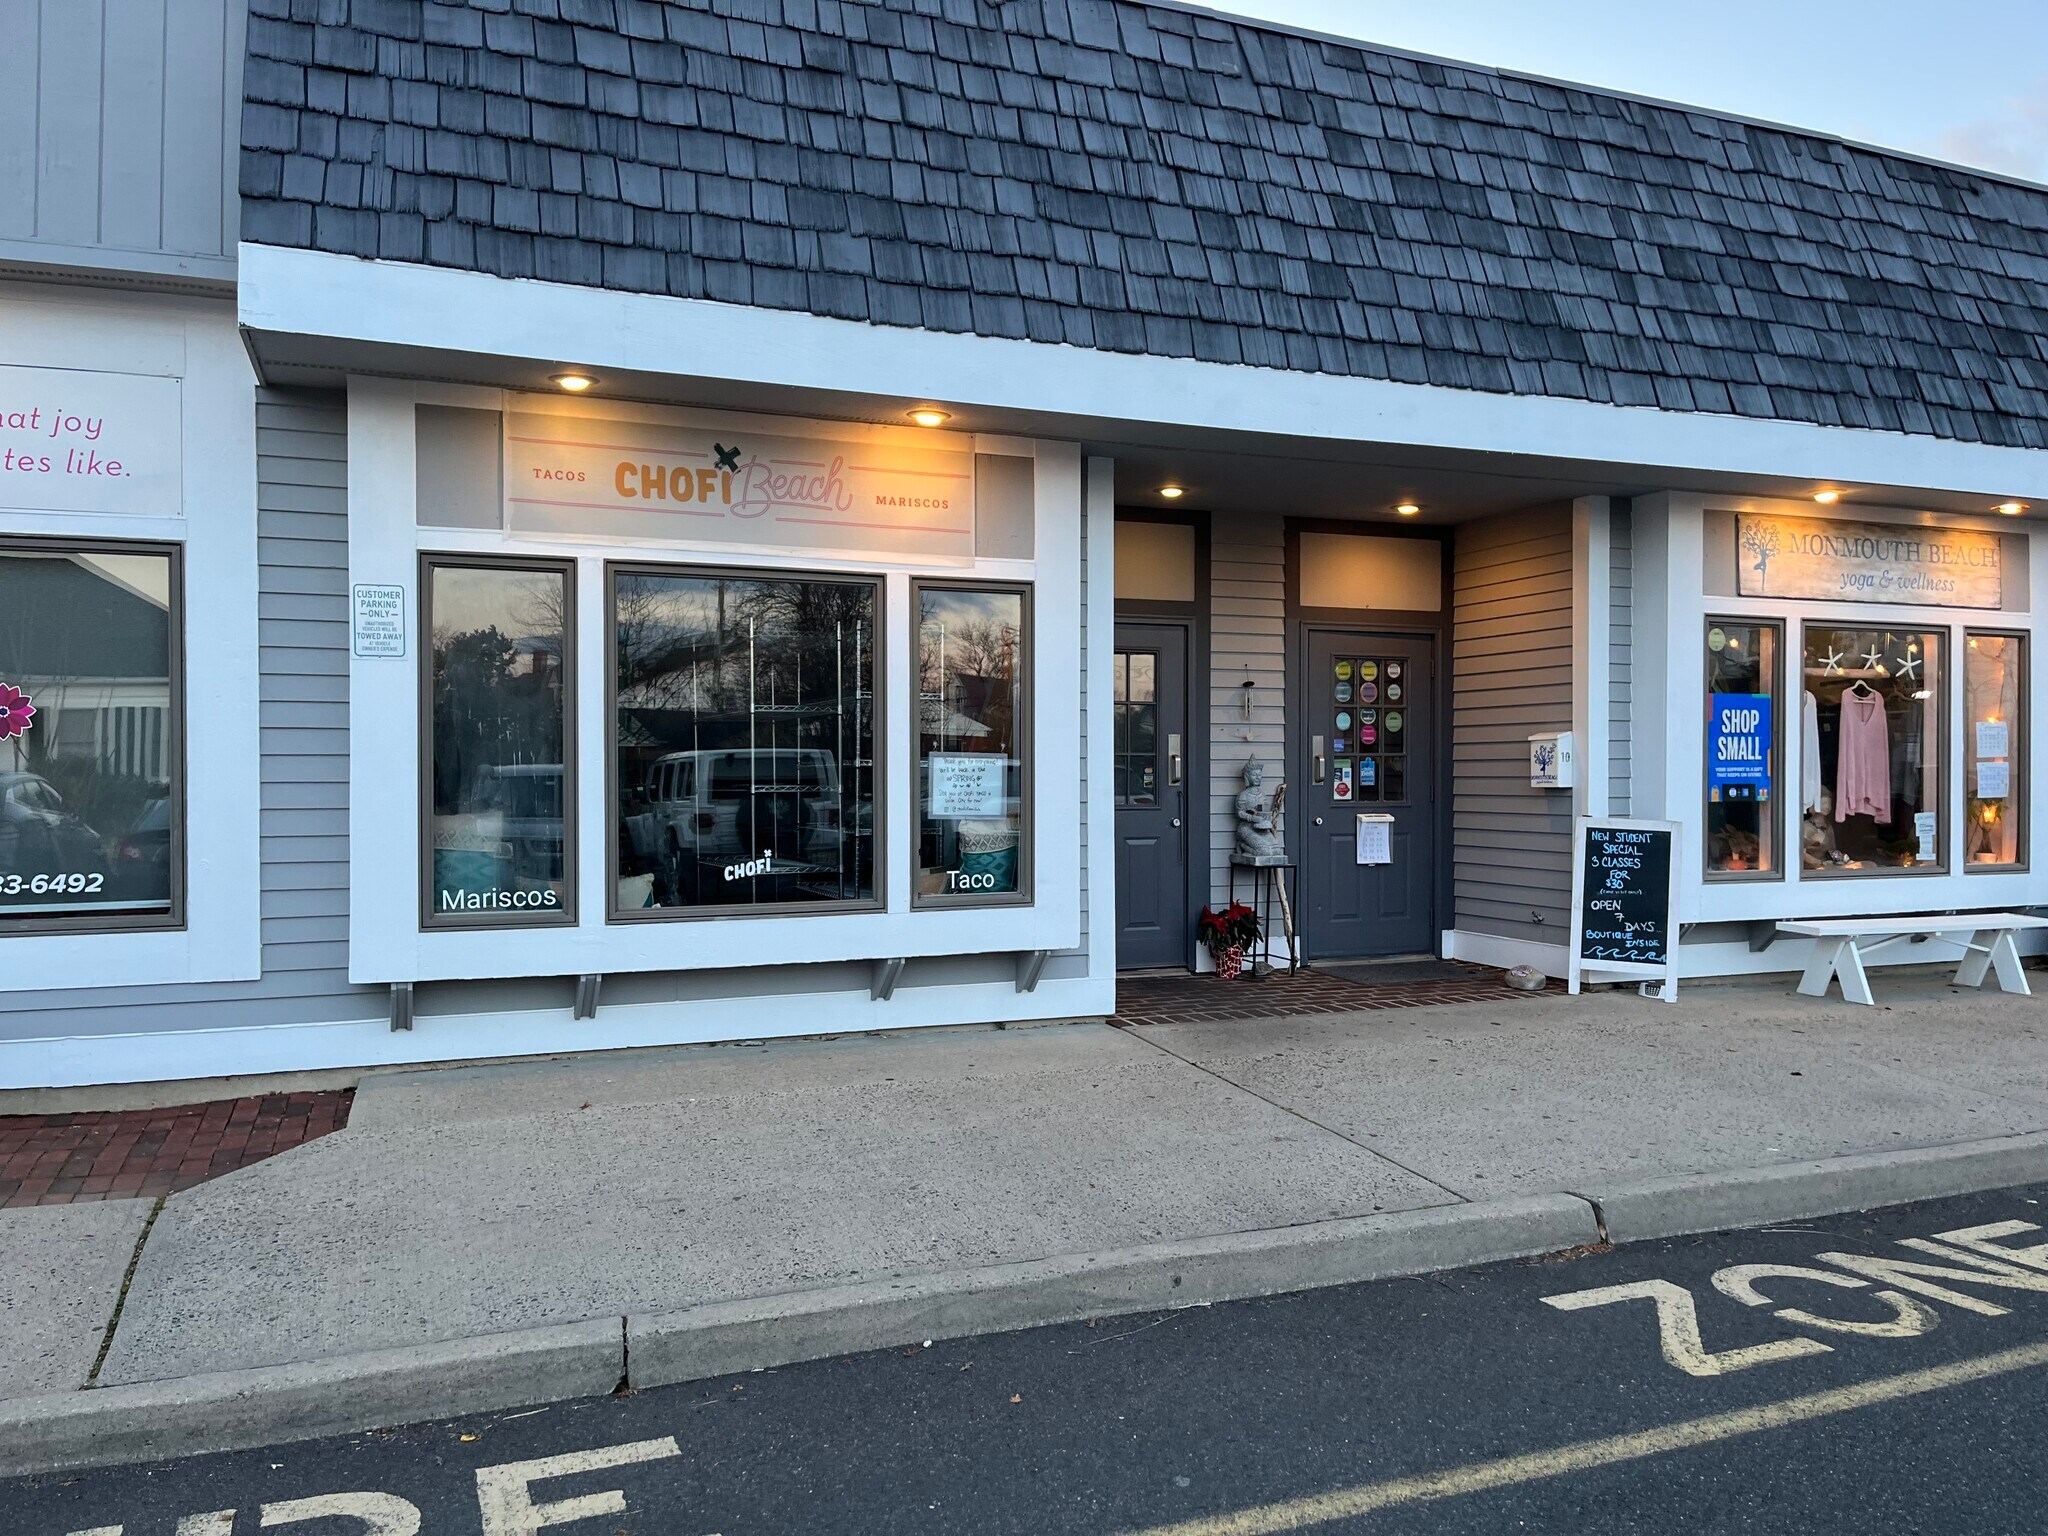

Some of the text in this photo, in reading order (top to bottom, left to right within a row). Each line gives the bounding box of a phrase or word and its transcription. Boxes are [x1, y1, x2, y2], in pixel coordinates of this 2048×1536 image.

[49, 408, 103, 440] joy
[66, 448, 131, 477] like.
[532, 468, 587, 483] TACOS
[729, 454, 854, 519] Beach
[875, 495, 951, 510] MARISCOS
[1788, 532, 1998, 568] MONMOUTH BEACH
[1839, 569, 1956, 592] yoga & wellness
[356, 590, 400, 600] CUSTOMER
[361, 600, 397, 608] PARKING
[356, 632, 403, 641] TOWED AWAY
[1721, 708, 1760, 734] SHOP
[1717, 735, 1763, 761] SMALL
[1591, 830, 1654, 844] NEW STUDENT
[1602, 842, 1643, 856] SPECIAL
[1591, 855, 1641, 869] 3 CLASSES
[946, 870, 995, 889] Taco
[1609, 869, 1631, 881] FOR
[1605, 878, 1624, 889] $30
[441, 887, 558, 911] Mariscos
[1590, 899, 1622, 911] OPEN
[1614, 912, 1625, 923] 7
[1585, 929, 1633, 940] BOUTIQUE
[1625, 939, 1660, 948] INSIDE
